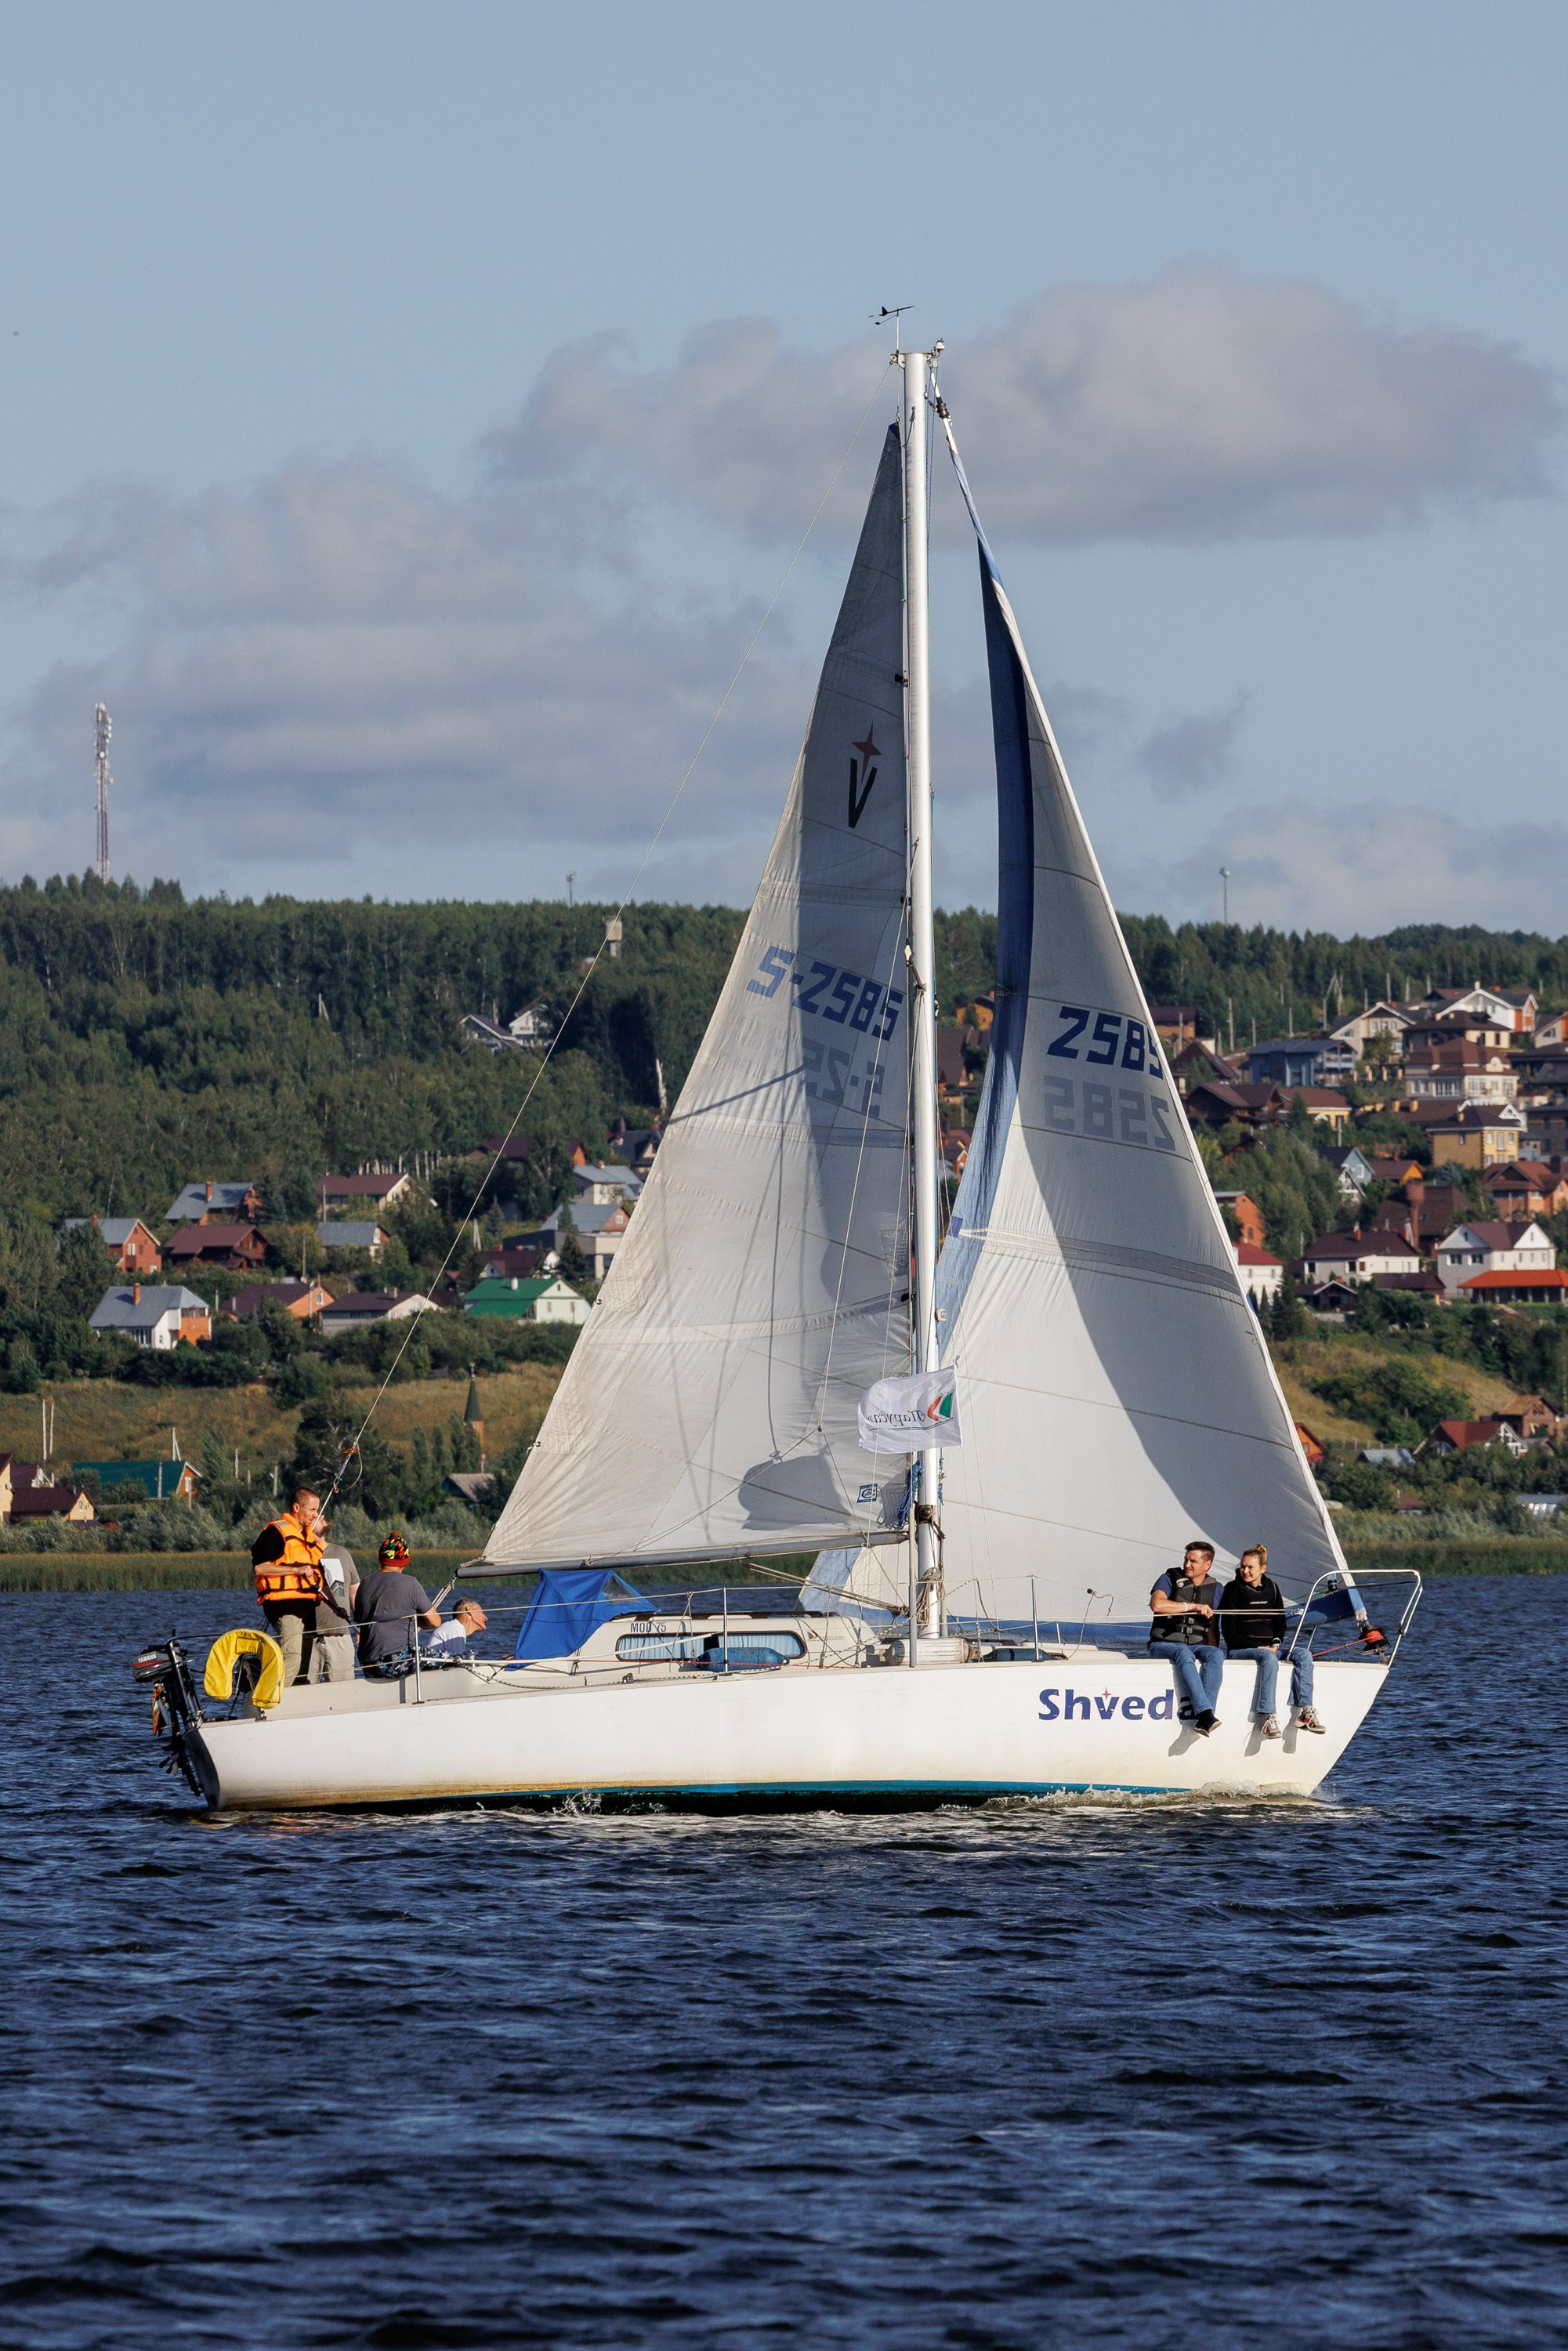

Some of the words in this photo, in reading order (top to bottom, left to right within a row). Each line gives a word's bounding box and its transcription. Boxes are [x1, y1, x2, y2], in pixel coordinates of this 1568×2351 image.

[746, 945, 904, 1041] S-2585
[1047, 1006, 1164, 1080] 2585
[656, 1622, 667, 1632] 75
[138, 1654, 157, 1663] YAMAHA
